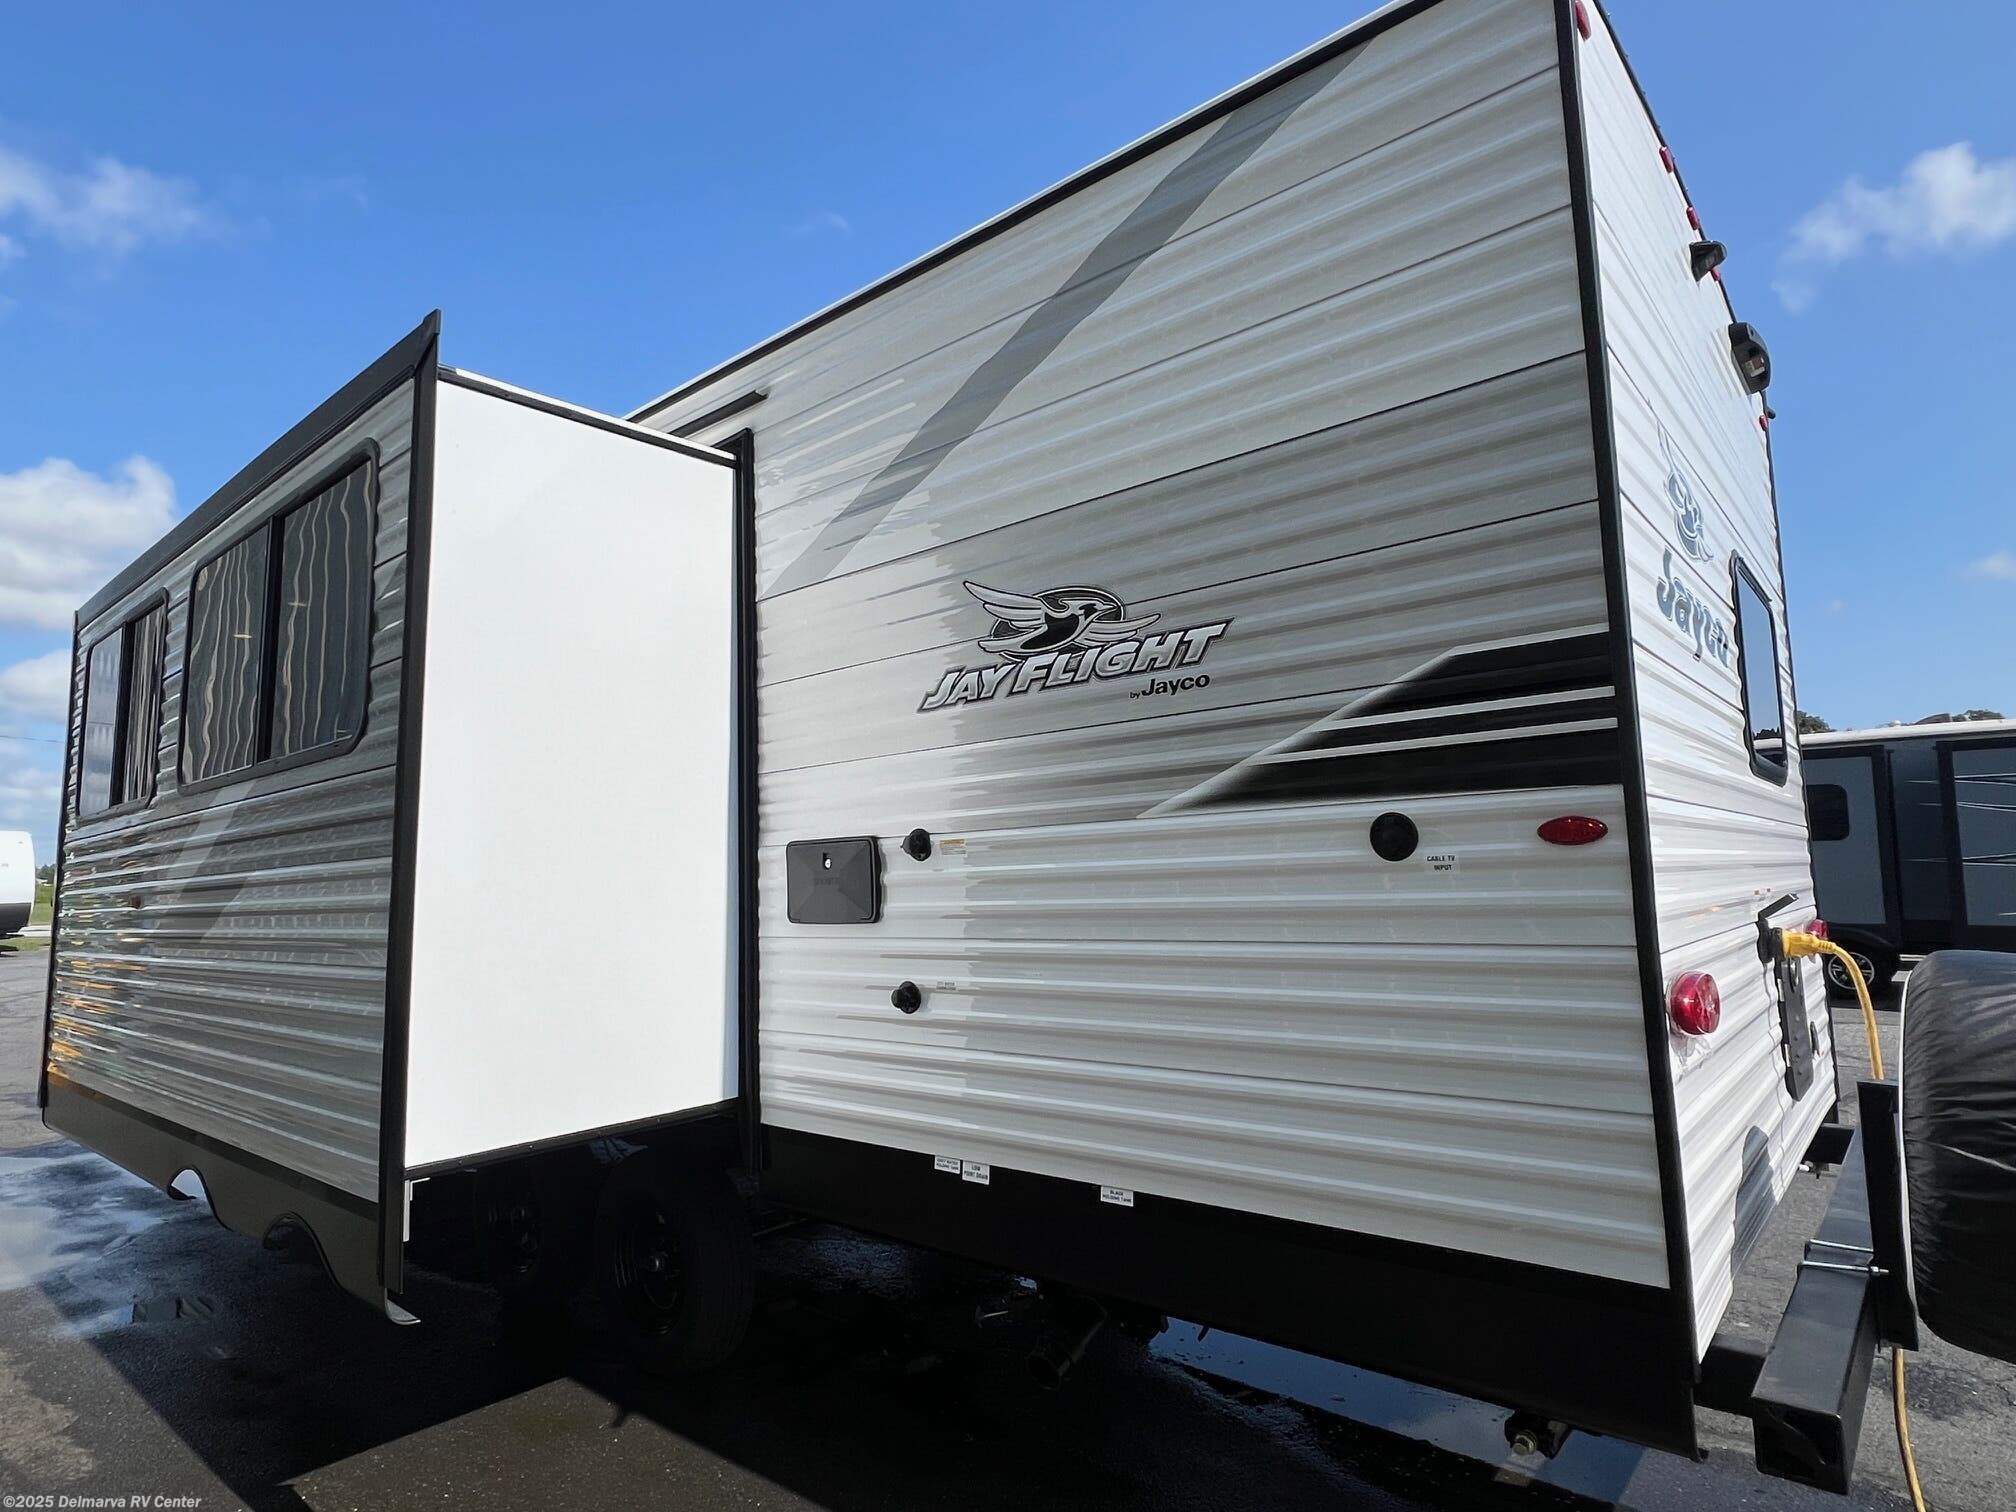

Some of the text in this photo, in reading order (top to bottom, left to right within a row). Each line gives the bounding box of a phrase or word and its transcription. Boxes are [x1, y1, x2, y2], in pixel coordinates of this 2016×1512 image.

[1656, 545, 1729, 668] Jayco
[917, 617, 1236, 713] JAY FLIGHT
[1129, 674, 1210, 700] by Jayco
